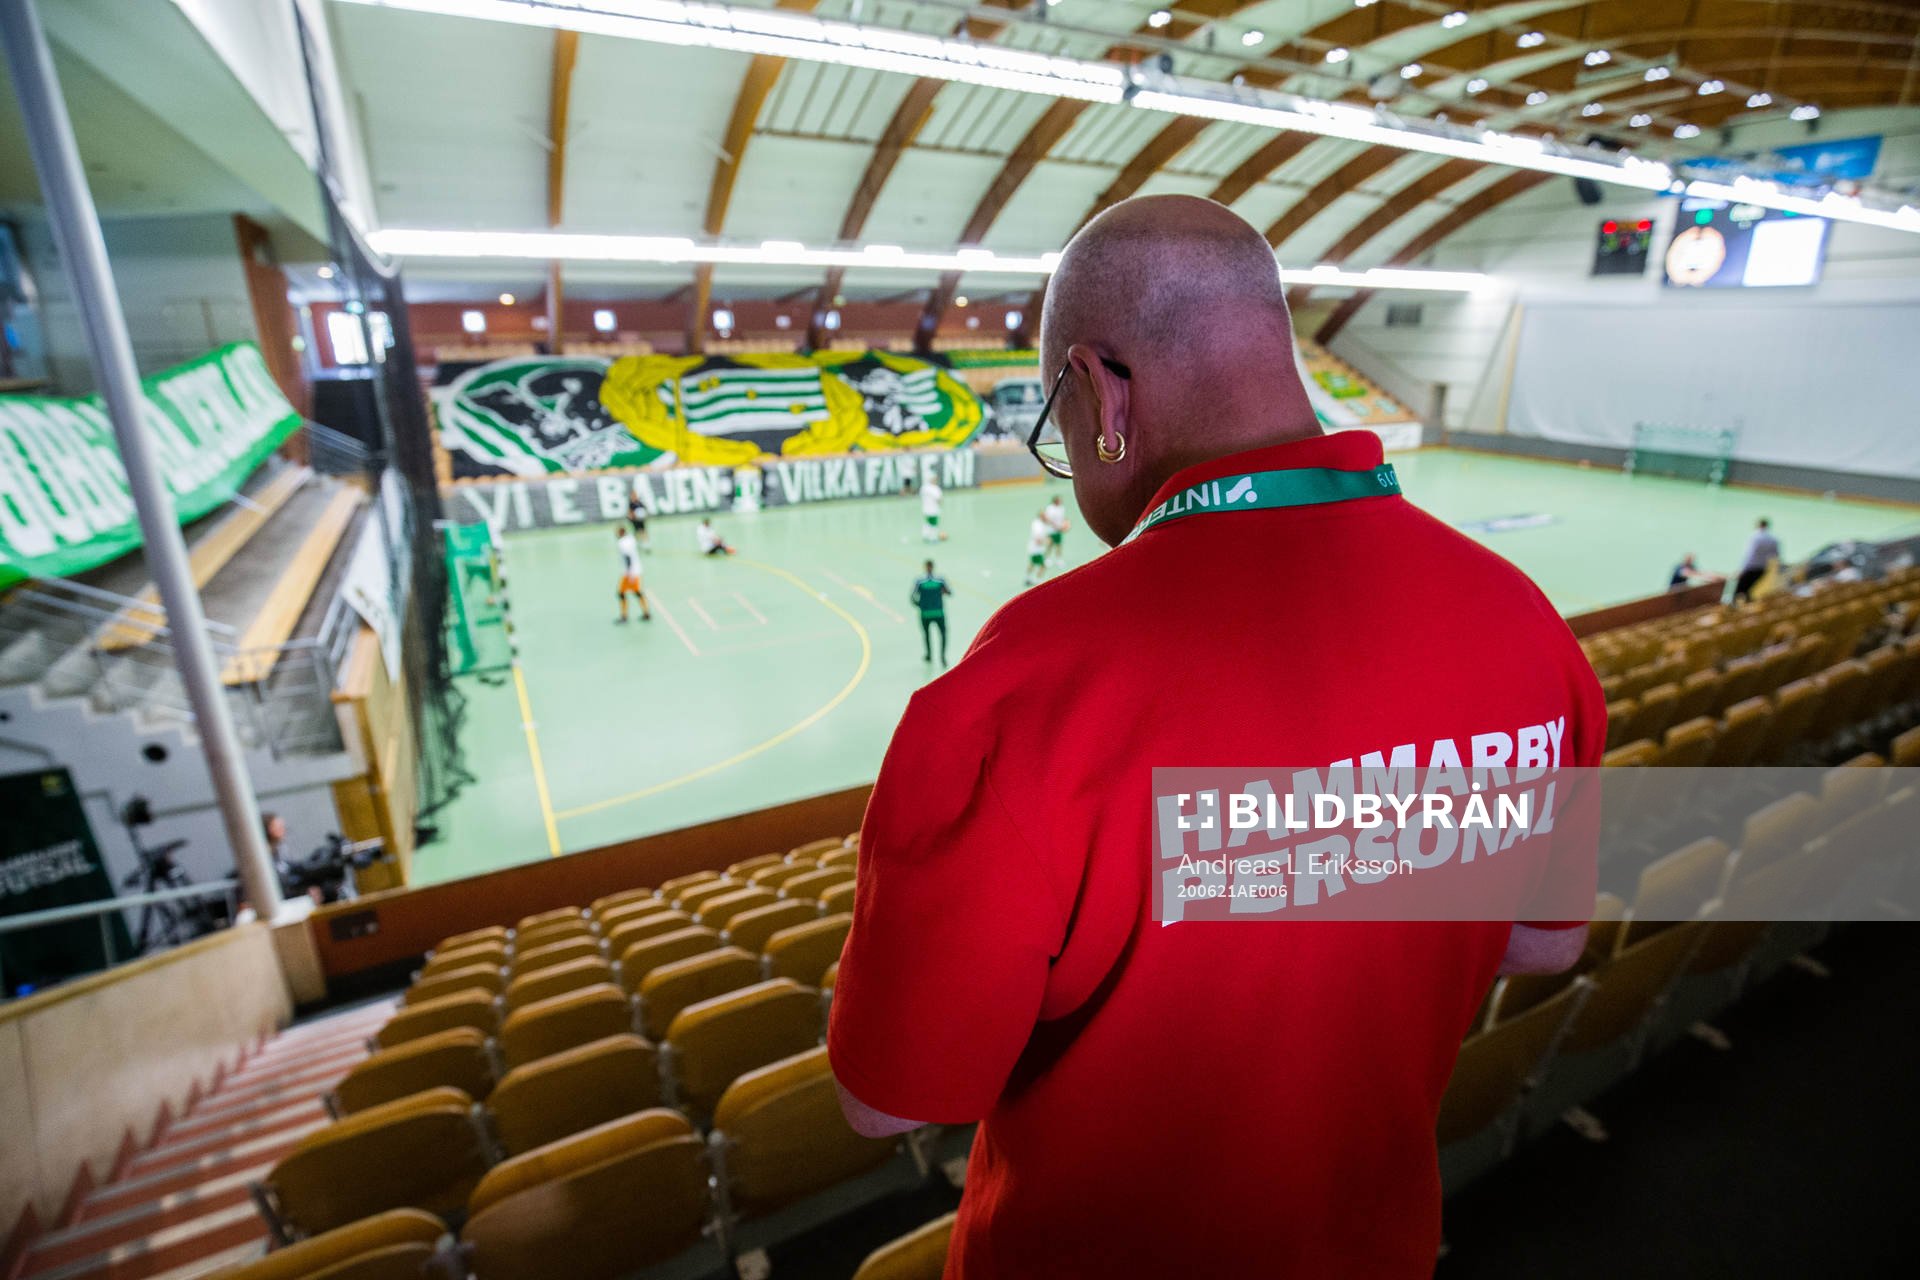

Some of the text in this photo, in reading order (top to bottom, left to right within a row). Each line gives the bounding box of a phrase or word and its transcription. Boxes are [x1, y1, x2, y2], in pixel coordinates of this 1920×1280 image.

[546, 477, 585, 525] E
[596, 467, 722, 519] BAJEN
[777, 457, 861, 503] VILKA
[943, 449, 975, 488] NI
[1157, 715, 1565, 859] HAMMARBY
[1161, 781, 1557, 927] PERSONAL
